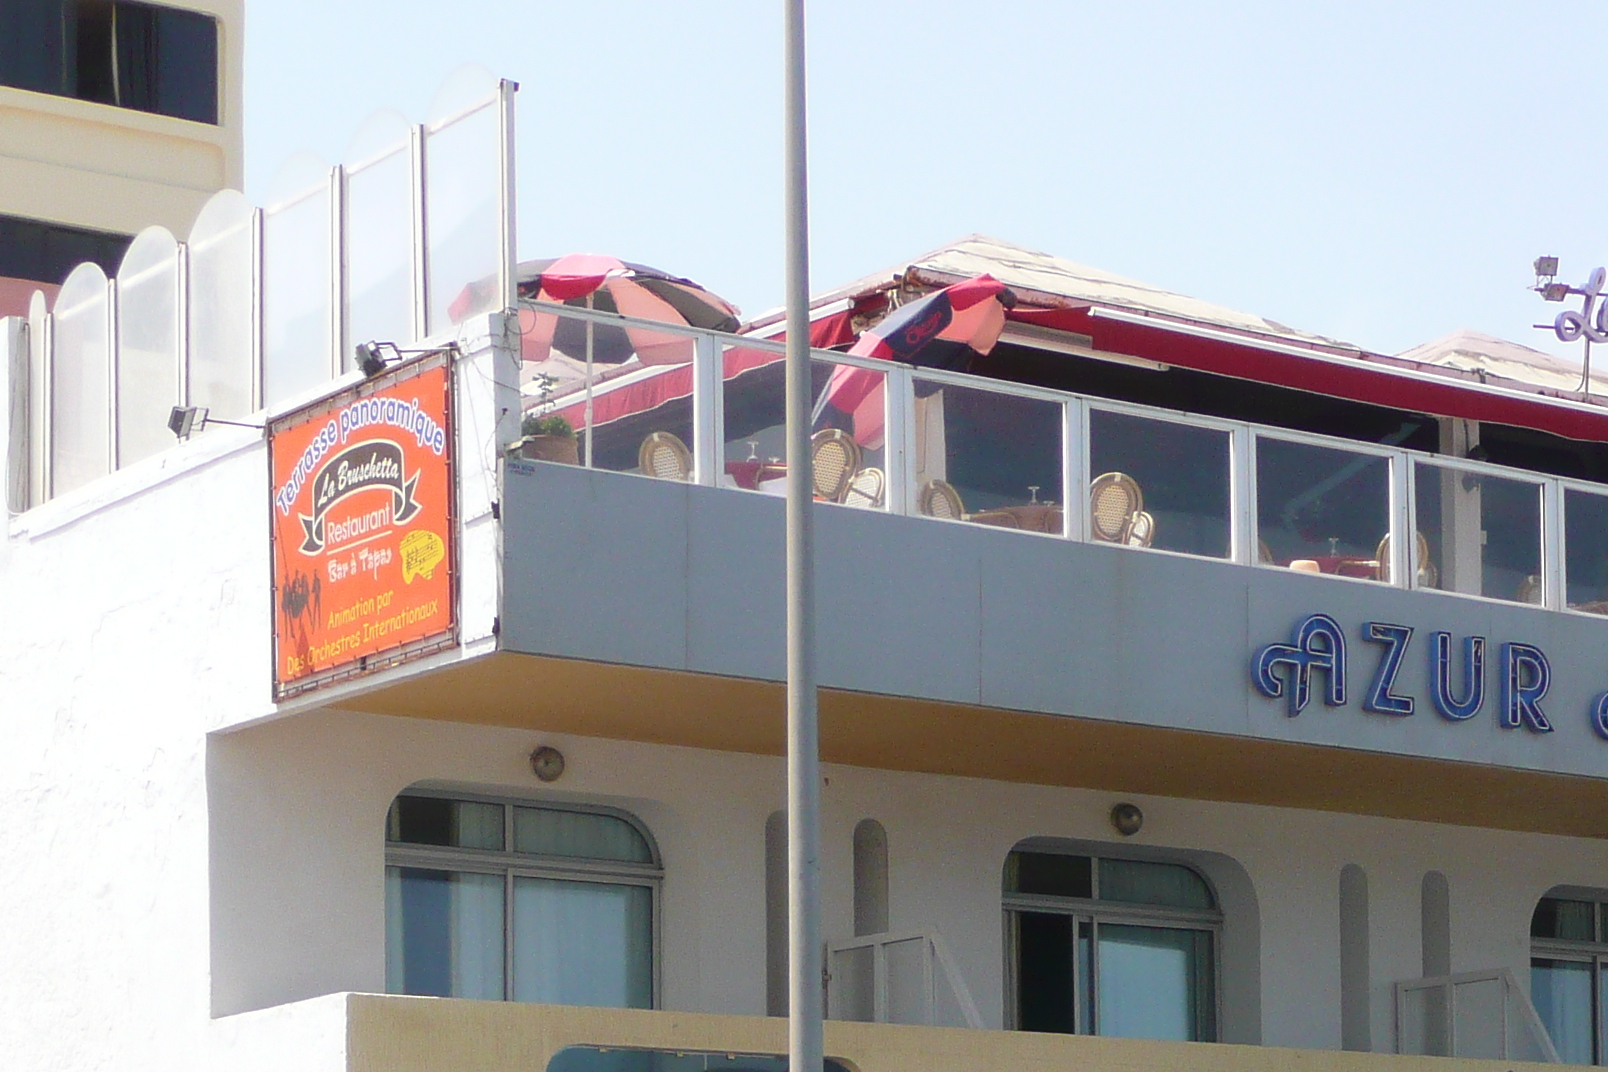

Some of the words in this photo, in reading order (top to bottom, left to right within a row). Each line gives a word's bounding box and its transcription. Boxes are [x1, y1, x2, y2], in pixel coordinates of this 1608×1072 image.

[277, 421, 337, 515] Terrasse
[340, 398, 444, 454] panoramique
[318, 473, 336, 507] La
[337, 452, 399, 491] Bruschetta
[327, 503, 390, 544] Restaurant
[328, 559, 348, 582] Bar
[350, 553, 357, 575] à
[359, 547, 392, 580] Tapas
[287, 653, 304, 675] Des
[308, 632, 361, 665] Orchestres
[363, 599, 438, 643] Internationaux
[327, 597, 375, 630] Animation
[377, 590, 394, 614] par
[1251, 613, 1554, 734] AZUR
